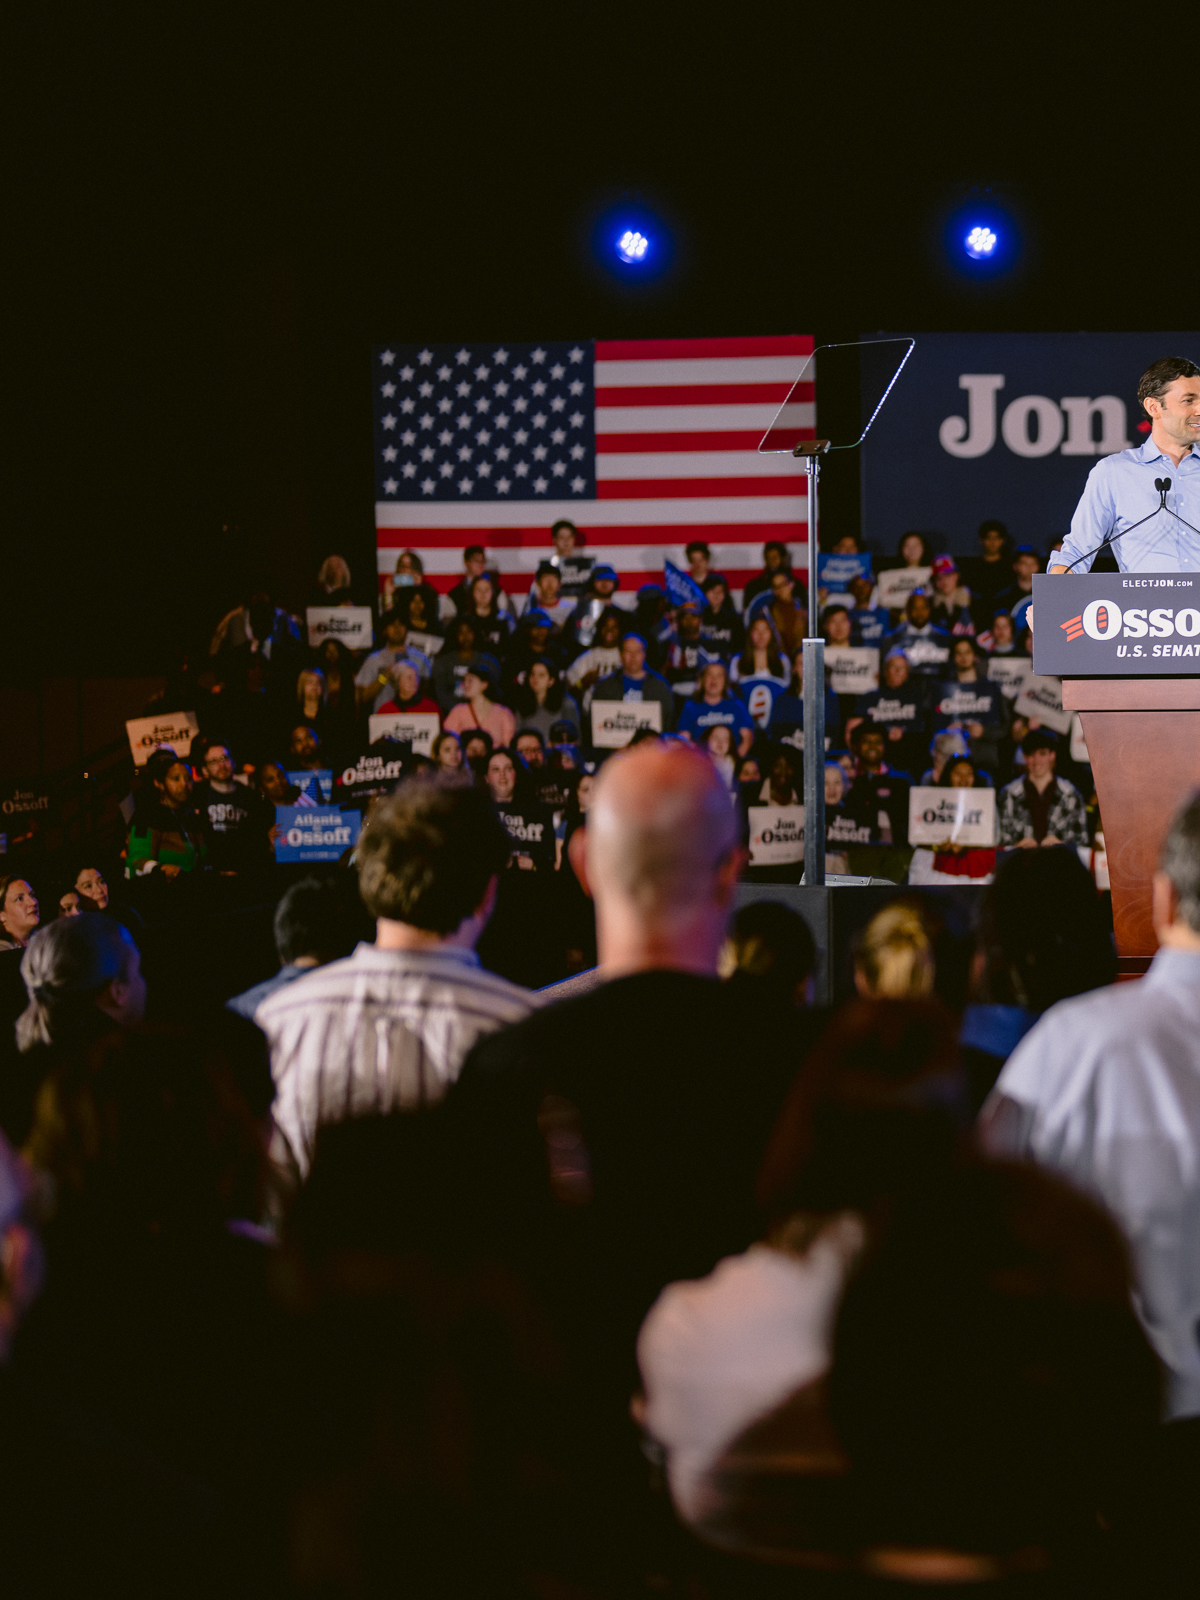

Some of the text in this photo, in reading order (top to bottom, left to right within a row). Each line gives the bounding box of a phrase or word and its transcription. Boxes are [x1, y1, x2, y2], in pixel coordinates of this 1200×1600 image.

[939, 373, 1133, 459] Jon
[1122, 579, 1194, 588] ELECTJON.COM
[1116, 645, 1148, 658] U.S.
[356, 755, 384, 770] Jon
[342, 760, 403, 786] Ossoff
[2, 795, 49, 815] Ossoff
[294, 813, 343, 827] Atlanta
[287, 826, 352, 848] Ossoff
